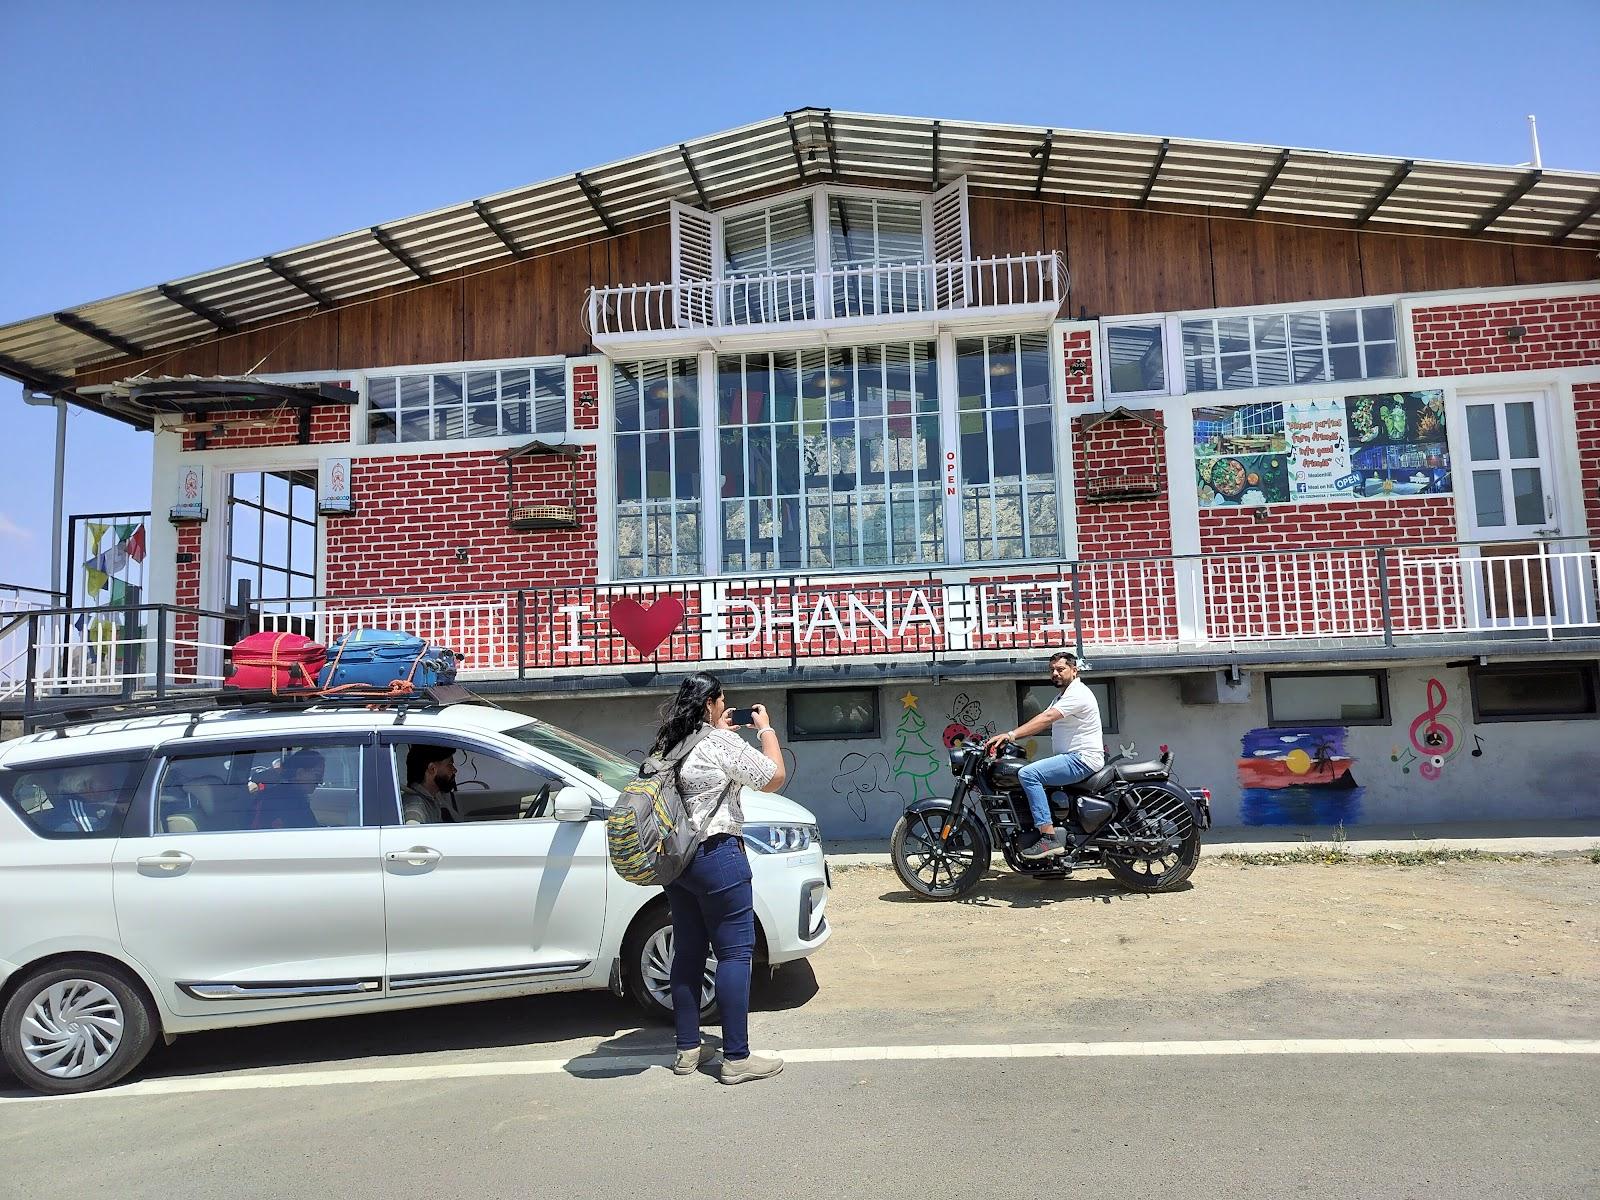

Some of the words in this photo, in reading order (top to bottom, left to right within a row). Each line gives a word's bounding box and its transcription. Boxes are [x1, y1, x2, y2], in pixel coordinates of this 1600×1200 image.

[946, 452, 956, 496] OPEN
[1336, 473, 1360, 488] OPEN
[558, 605, 591, 652] I
[711, 581, 1076, 648] DHANAULTI
